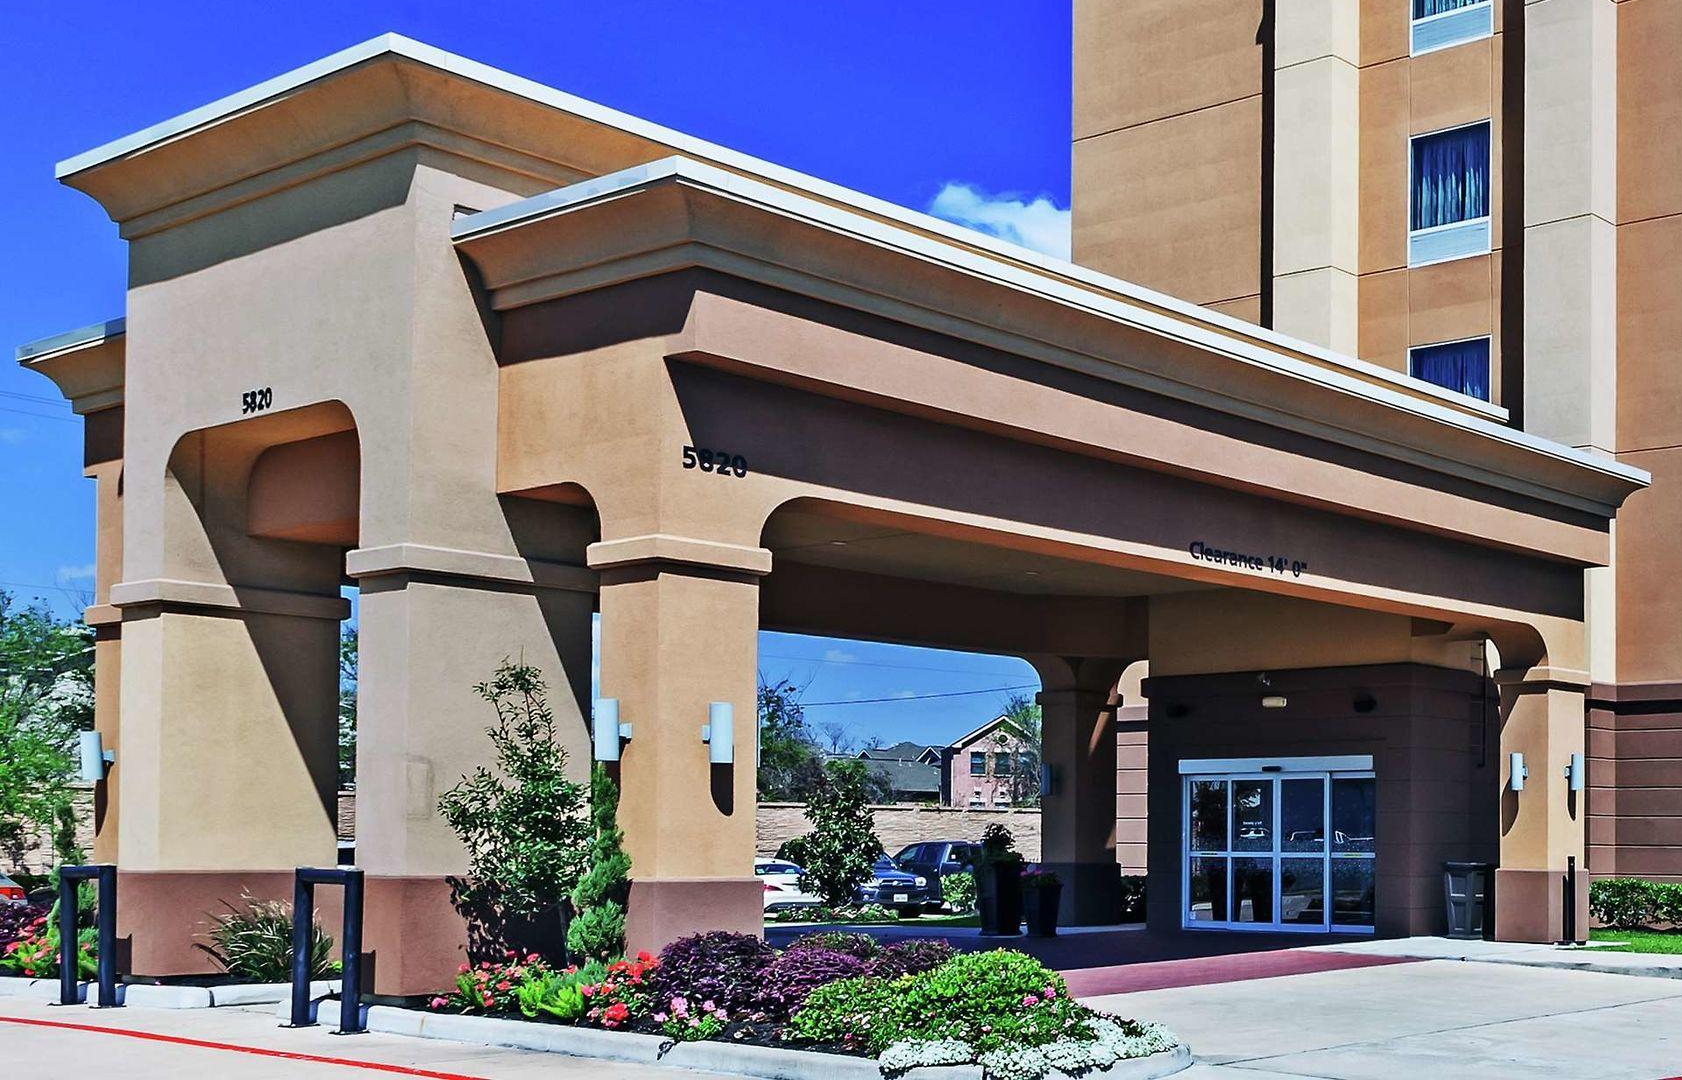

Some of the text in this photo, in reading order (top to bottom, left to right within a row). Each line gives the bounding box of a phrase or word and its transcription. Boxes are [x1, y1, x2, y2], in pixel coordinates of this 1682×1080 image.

[242, 387, 272, 414] 5820
[682, 445, 747, 478] 5820
[1189, 540, 1264, 571] Clearance
[1268, 555, 1288, 574] 14'
